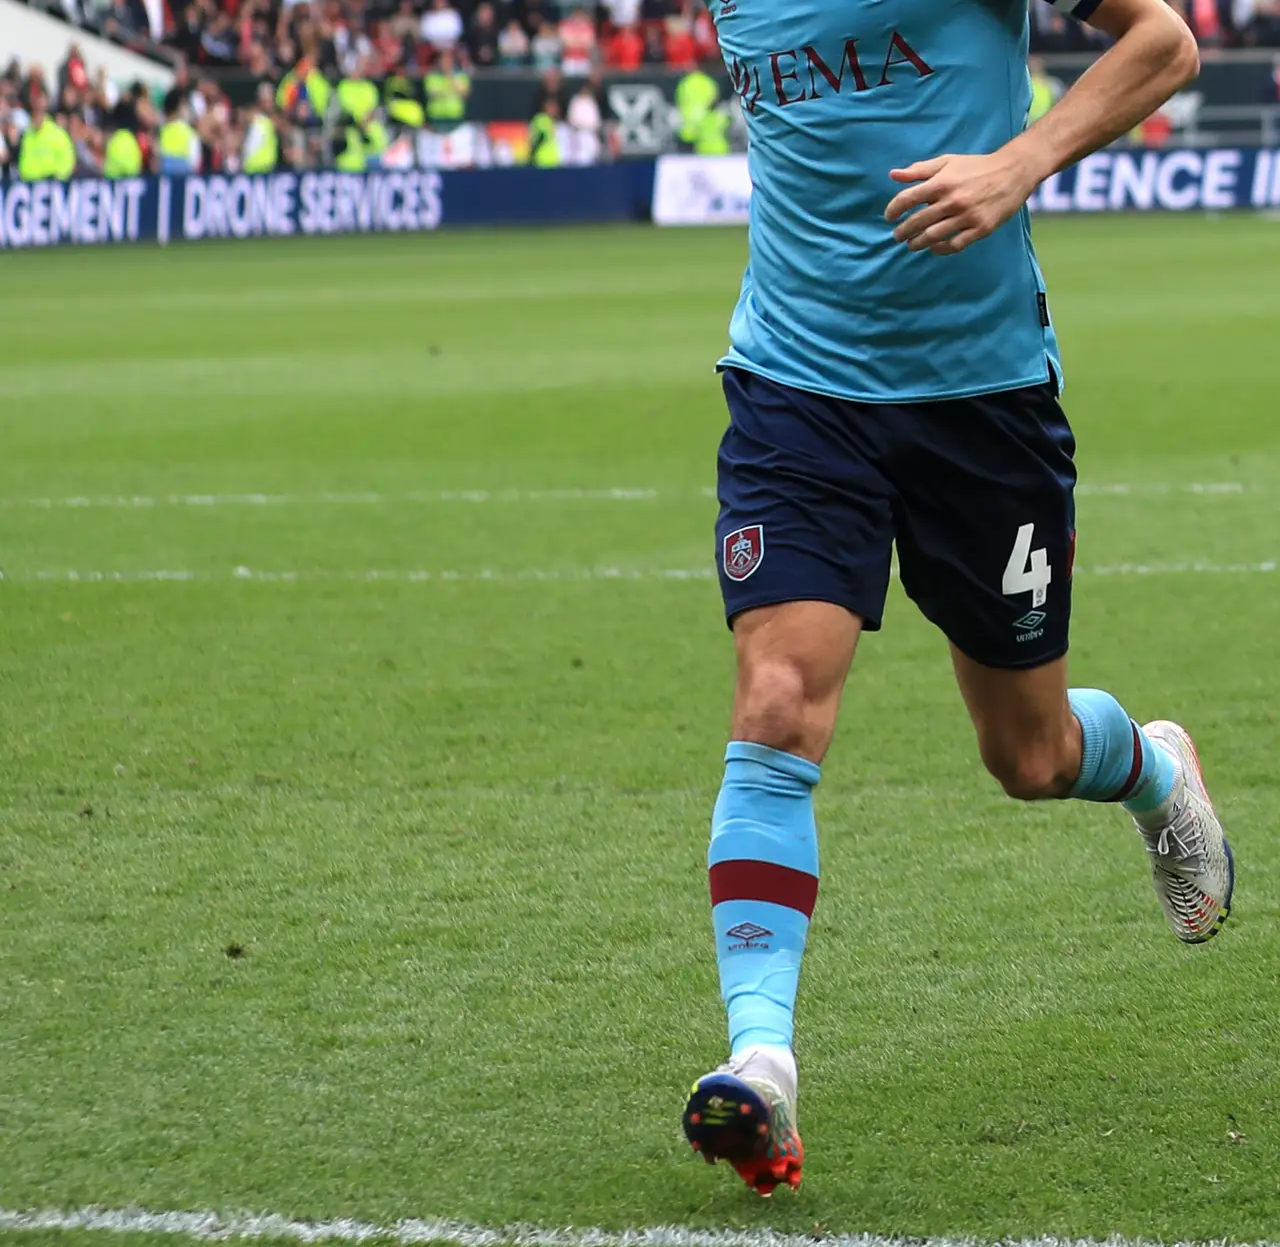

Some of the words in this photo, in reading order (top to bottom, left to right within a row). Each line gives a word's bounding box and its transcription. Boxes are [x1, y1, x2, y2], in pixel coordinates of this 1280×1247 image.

[767, 31, 936, 106] EMA
[0, 178, 145, 246] GEMENT
[183, 173, 295, 239] DRONE
[299, 170, 443, 232] SERVICES
[1002, 522, 1051, 608] 4
[1016, 628, 1044, 643] umbro
[728, 939, 769, 951] umbro
